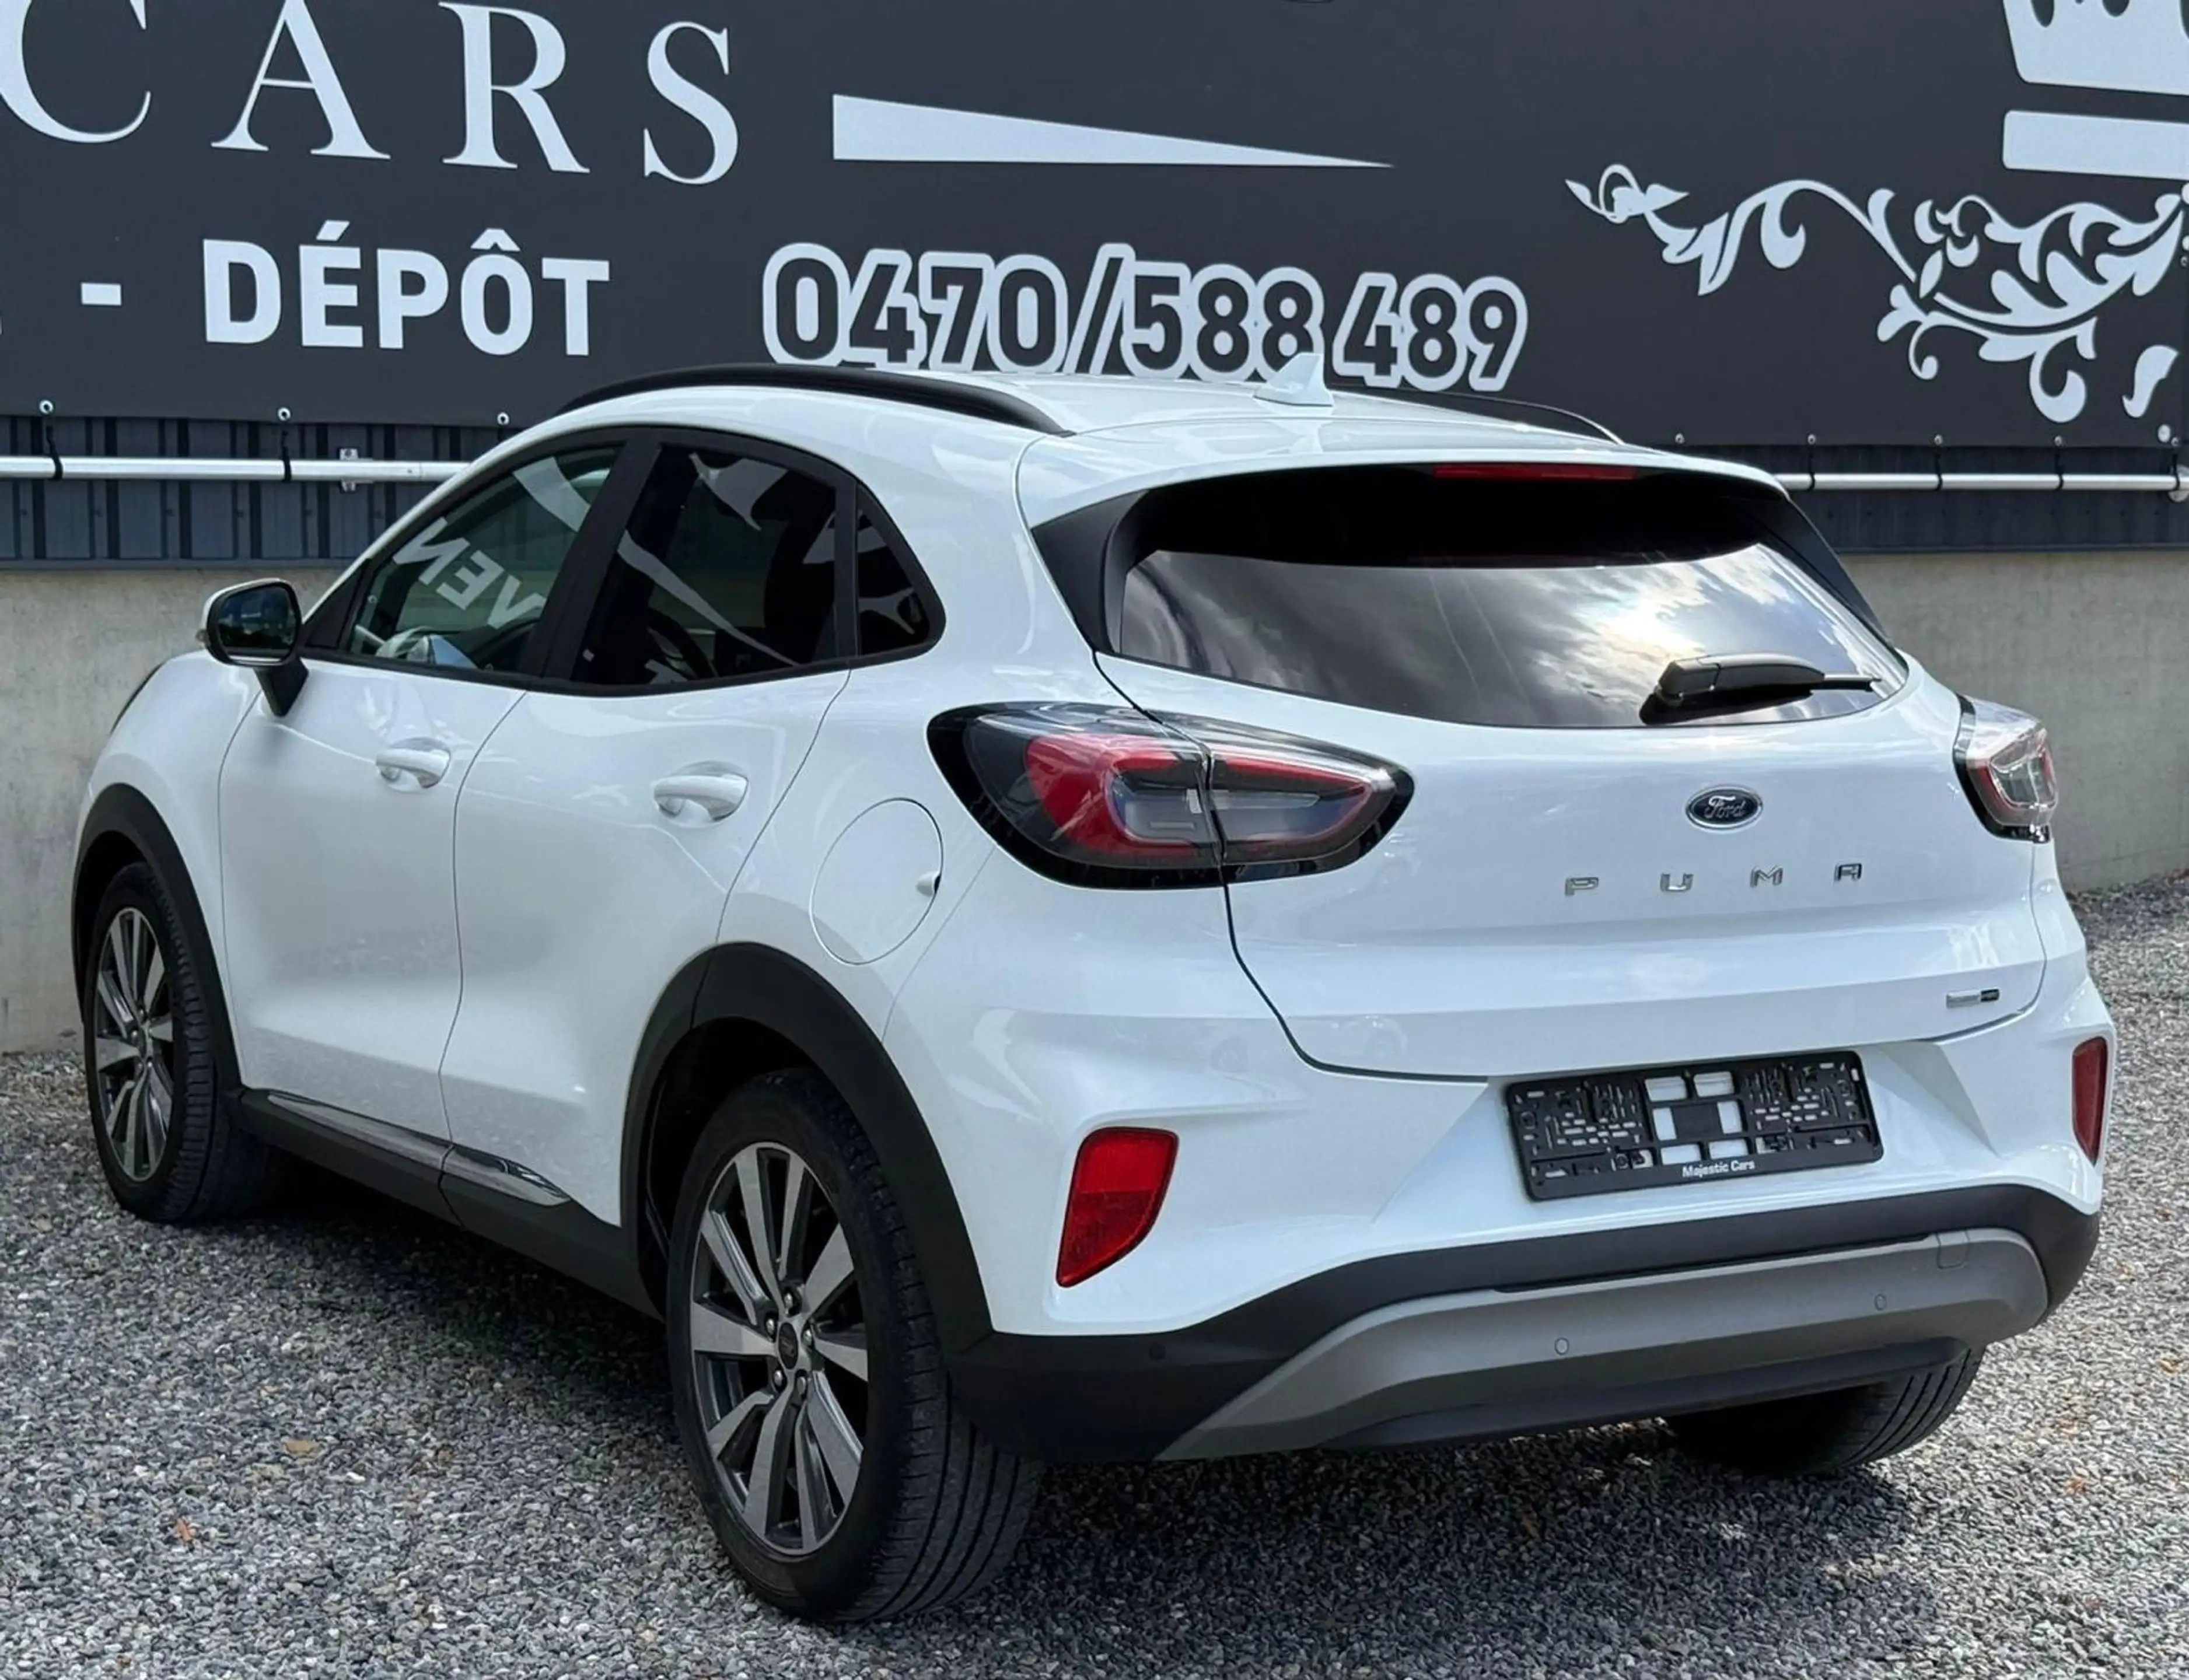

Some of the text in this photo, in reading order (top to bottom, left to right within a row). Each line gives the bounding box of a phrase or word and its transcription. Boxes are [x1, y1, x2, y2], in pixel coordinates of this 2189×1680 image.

[0, 0, 739, 185] CARS
[202, 220, 610, 356] DÉPÔT
[763, 243, 1529, 391] 0470/588 489
[1564, 862, 1863, 896] PUMA
[1683, 1159, 1755, 1178] Majestic Cars
